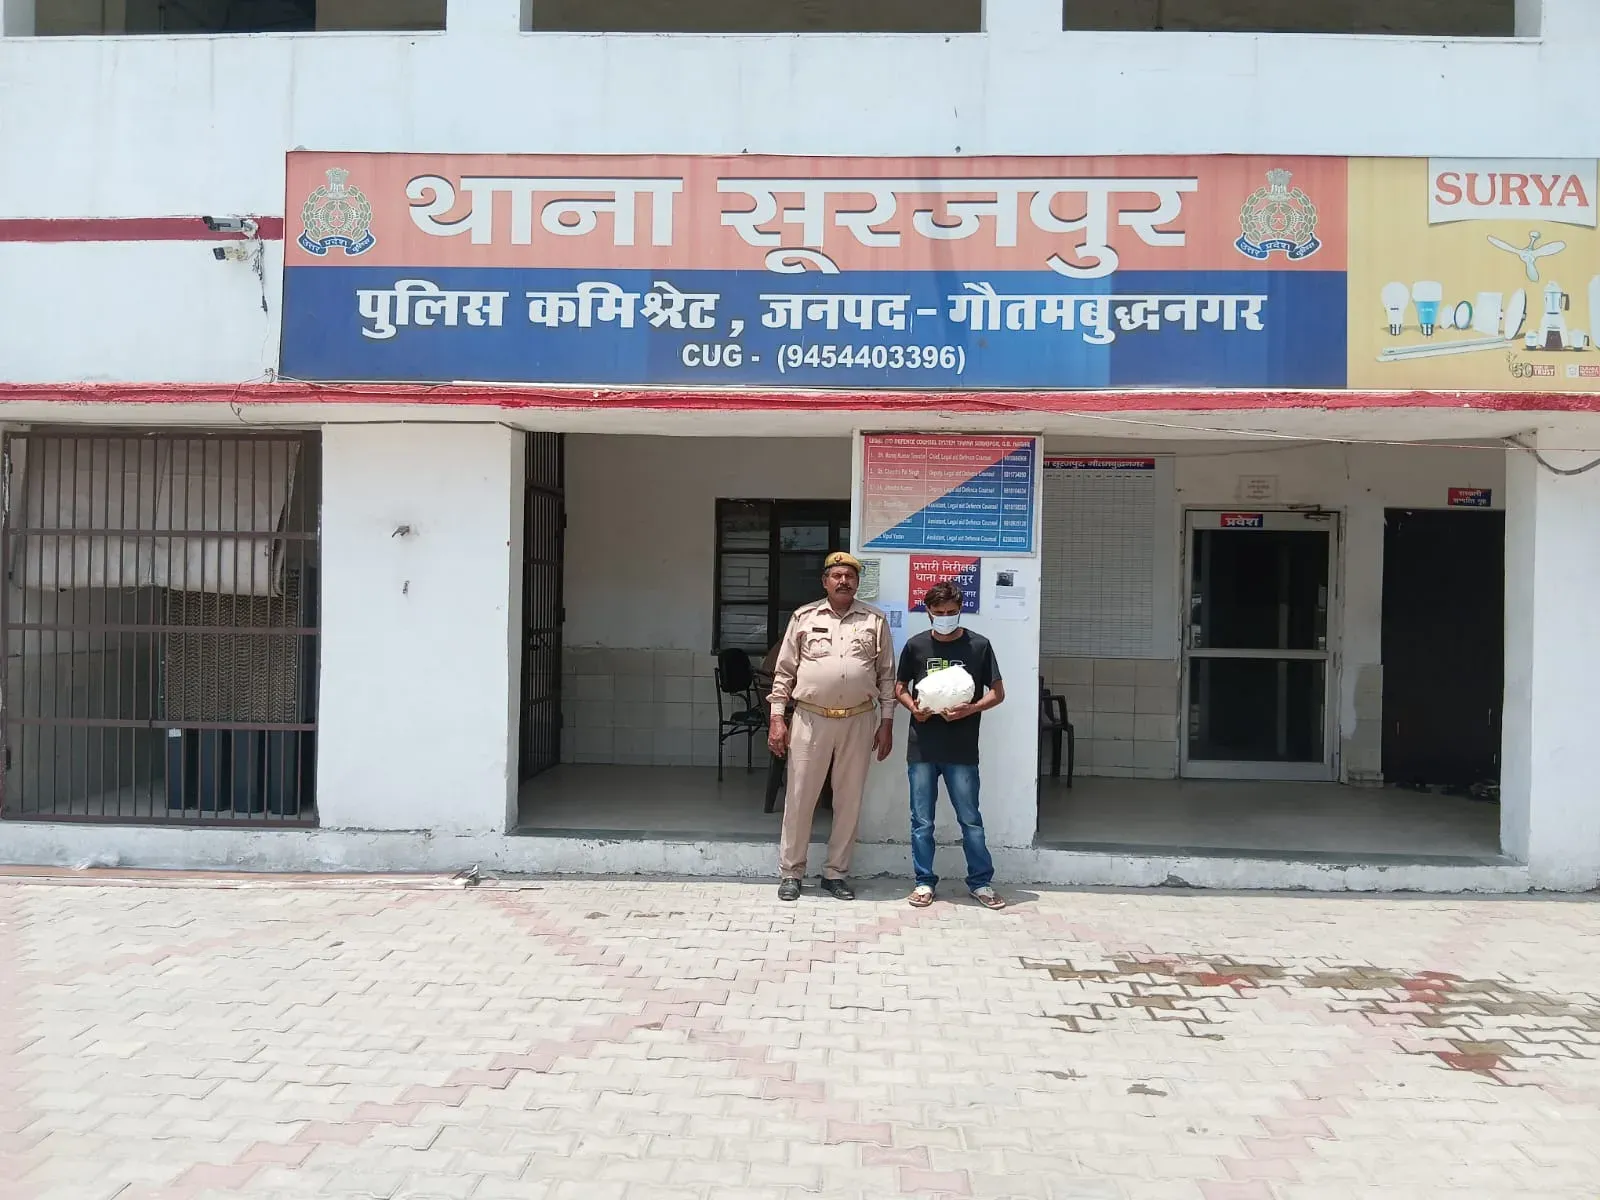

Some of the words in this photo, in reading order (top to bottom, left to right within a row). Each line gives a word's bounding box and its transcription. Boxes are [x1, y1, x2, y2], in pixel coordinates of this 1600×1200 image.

[1435, 172, 1589, 207] SURYA
[406, 175, 683, 246] थाना
[717, 177, 1198, 279] सूरजपुर
[356, 279, 510, 339] पुलिस
[681, 344, 743, 367] CUG
[777, 344, 966, 374] (9454403396)
[1224, 514, 1259, 527] प्रवेश
[912, 559, 939, 572] प्रभारी
[942, 560, 977, 572] निरीक्षक
[939, 574, 974, 586] सरजपुर
